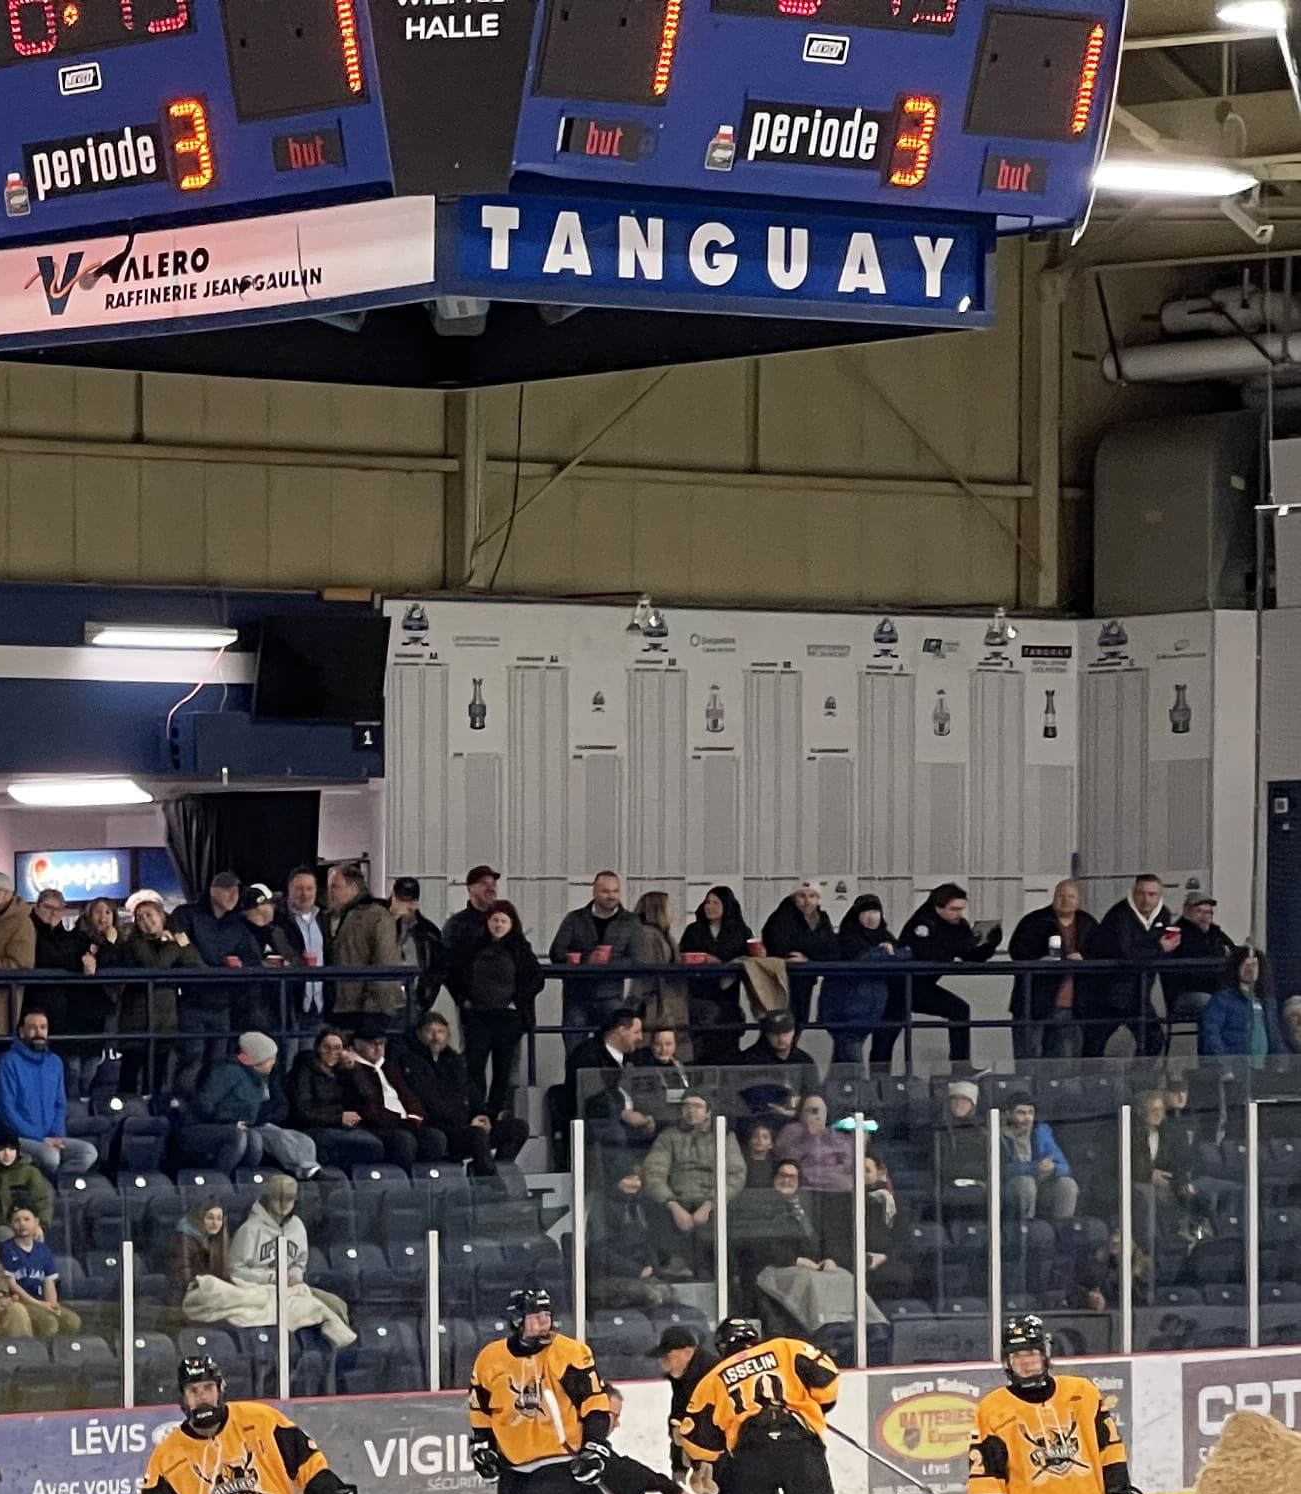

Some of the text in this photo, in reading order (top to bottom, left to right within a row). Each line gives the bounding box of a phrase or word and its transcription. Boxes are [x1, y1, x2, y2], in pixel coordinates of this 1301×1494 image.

[405, 12, 499, 40] HALLE
[1071, 22, 1104, 136] 1
[169, 98, 214, 191] 3
[287, 135, 325, 169] but
[584, 121, 626, 158] but
[747, 107, 880, 161] periode
[891, 95, 937, 187] 3
[32, 126, 158, 201] periode
[997, 160, 1032, 194] but
[480, 204, 956, 299] TANGUAY
[104, 281, 198, 311] RAFFINERIE
[363, 730, 373, 745] 1
[70, 1418, 147, 1457] LÉVIS
[363, 1434, 476, 1478] VIGIL
